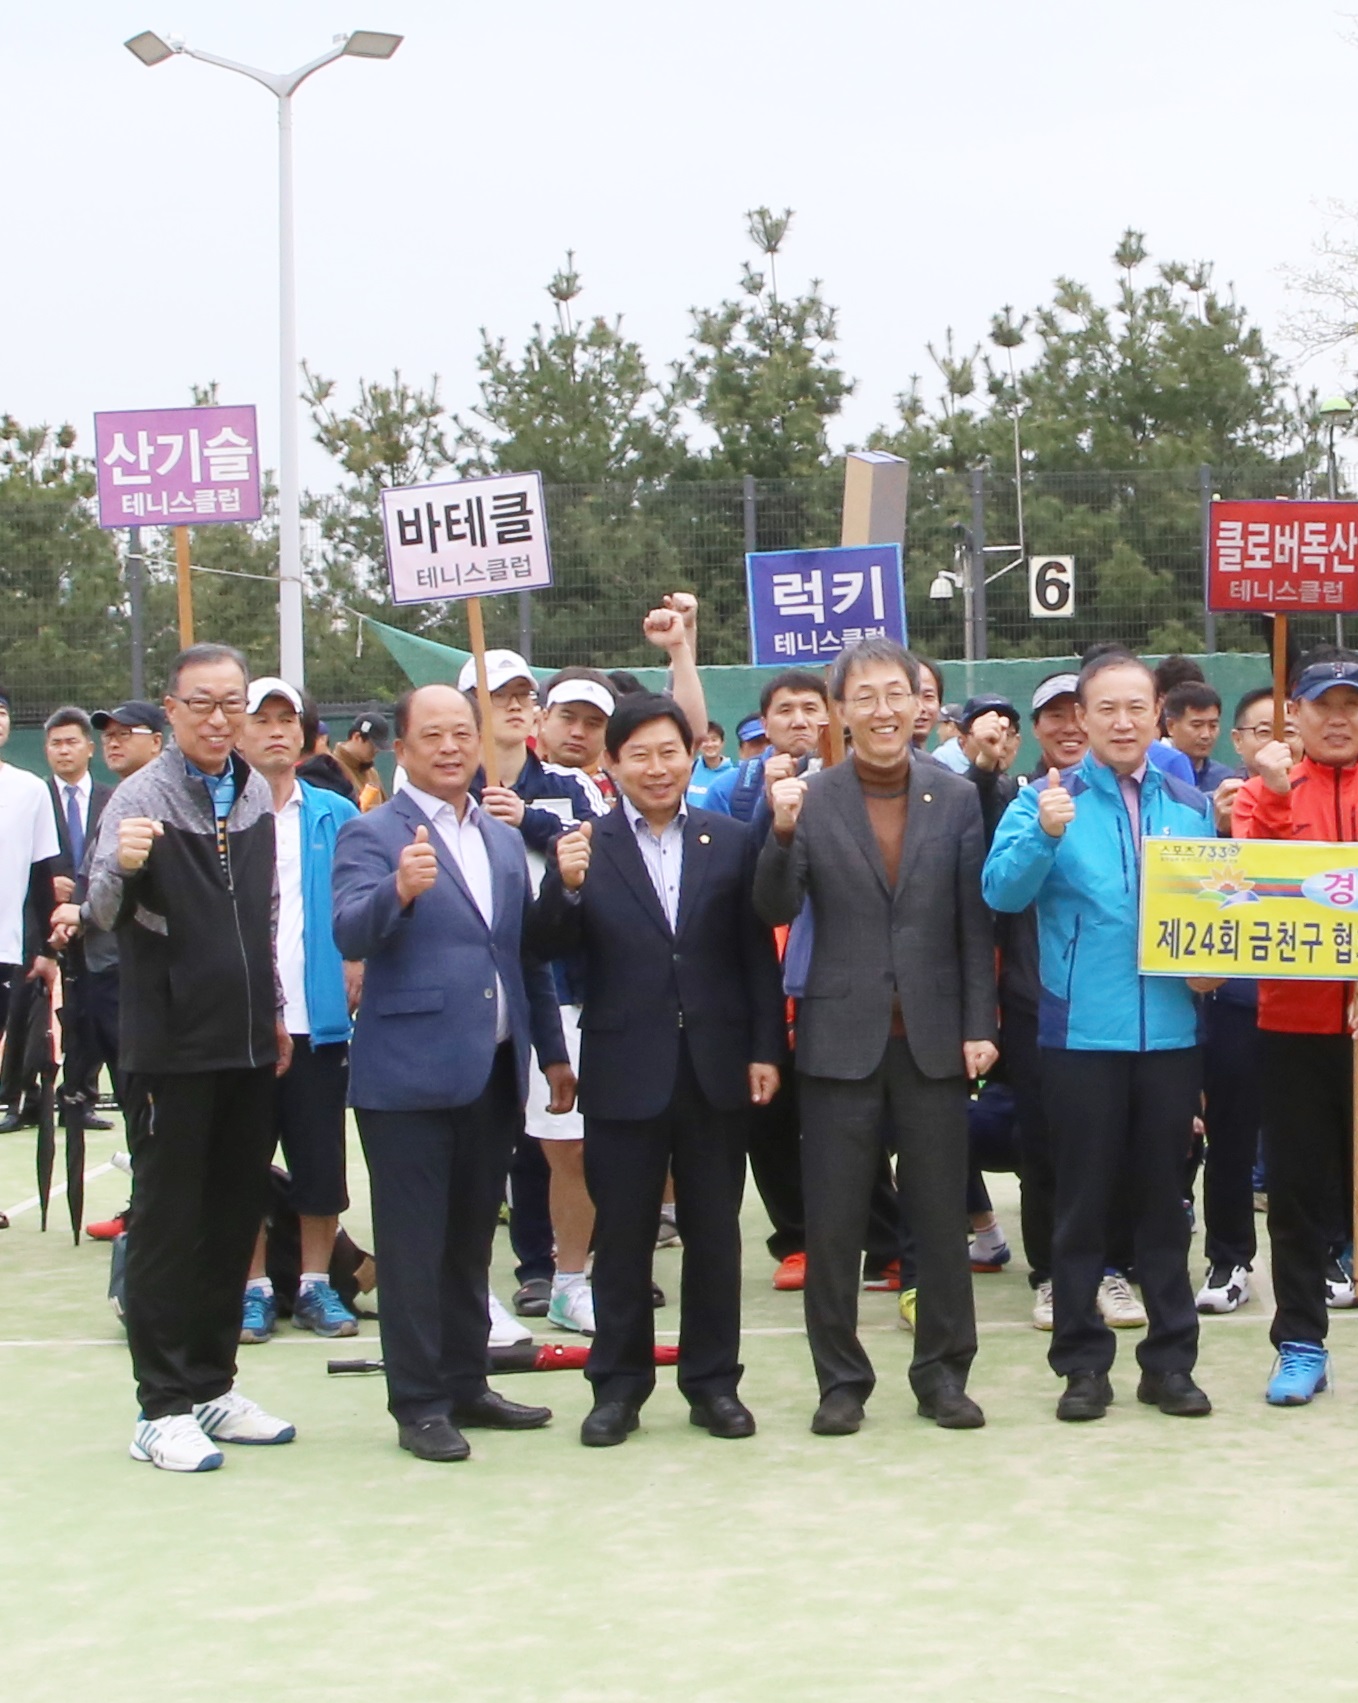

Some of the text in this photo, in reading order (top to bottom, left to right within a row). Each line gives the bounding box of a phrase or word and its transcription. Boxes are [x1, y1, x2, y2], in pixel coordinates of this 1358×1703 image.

[103, 427, 253, 485] 산기슬
[122, 488, 241, 517] 테니스클럽
[397, 491, 534, 553] 바테클
[416, 554, 532, 588] 테니스클럽
[1216, 521, 1358, 573] 클로버독산
[772, 566, 885, 624] 럭키
[1035, 561, 1070, 611] 6
[1229, 579, 1344, 603] 테니스클럽
[1157, 918, 1239, 961] 제24회
[1249, 921, 1323, 963] 금천구
